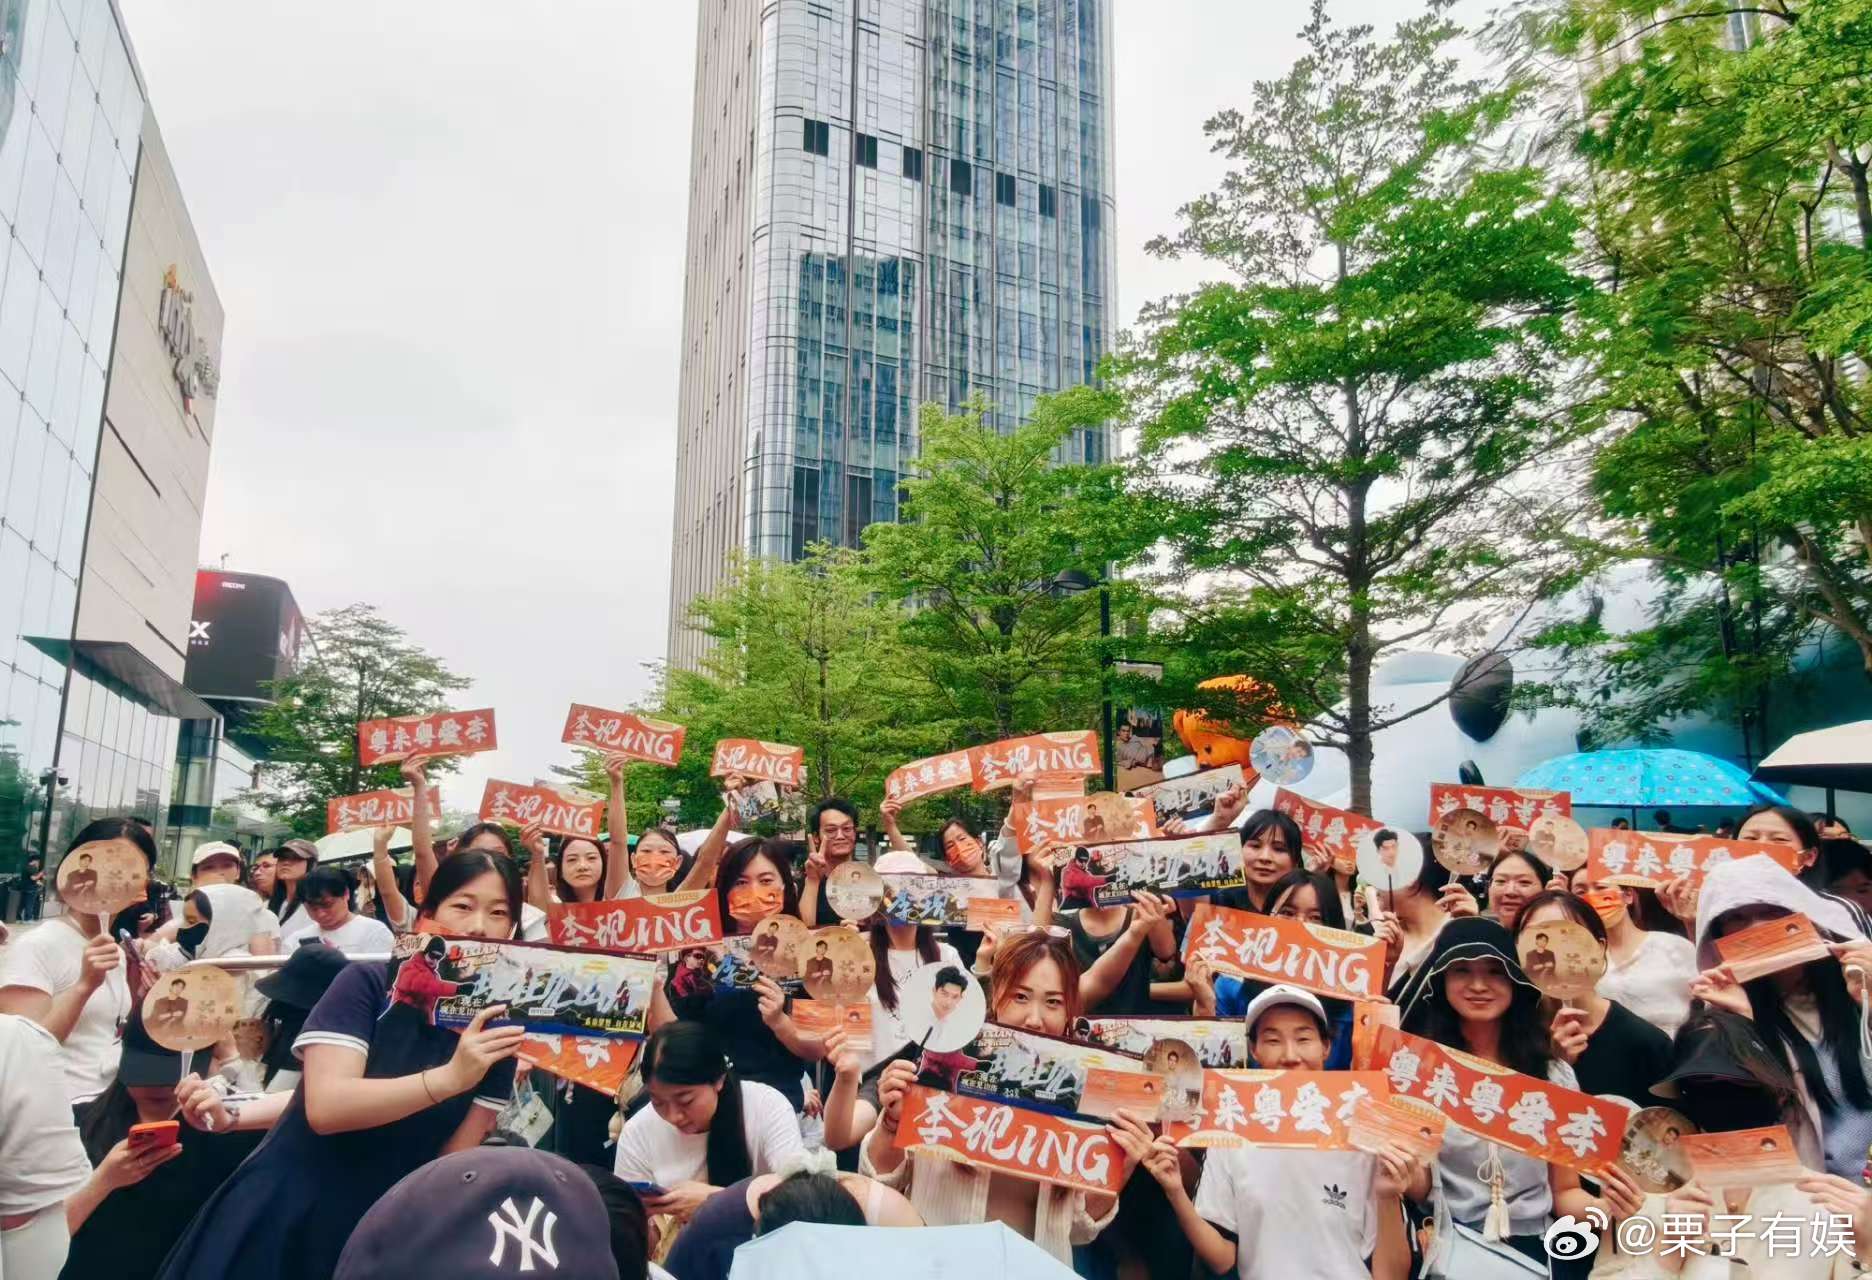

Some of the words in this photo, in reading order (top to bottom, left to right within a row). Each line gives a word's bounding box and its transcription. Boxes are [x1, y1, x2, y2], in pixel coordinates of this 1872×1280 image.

[1383, 1045, 1608, 1157] 粤来粤爱李
[487, 1196, 561, 1272] NY
